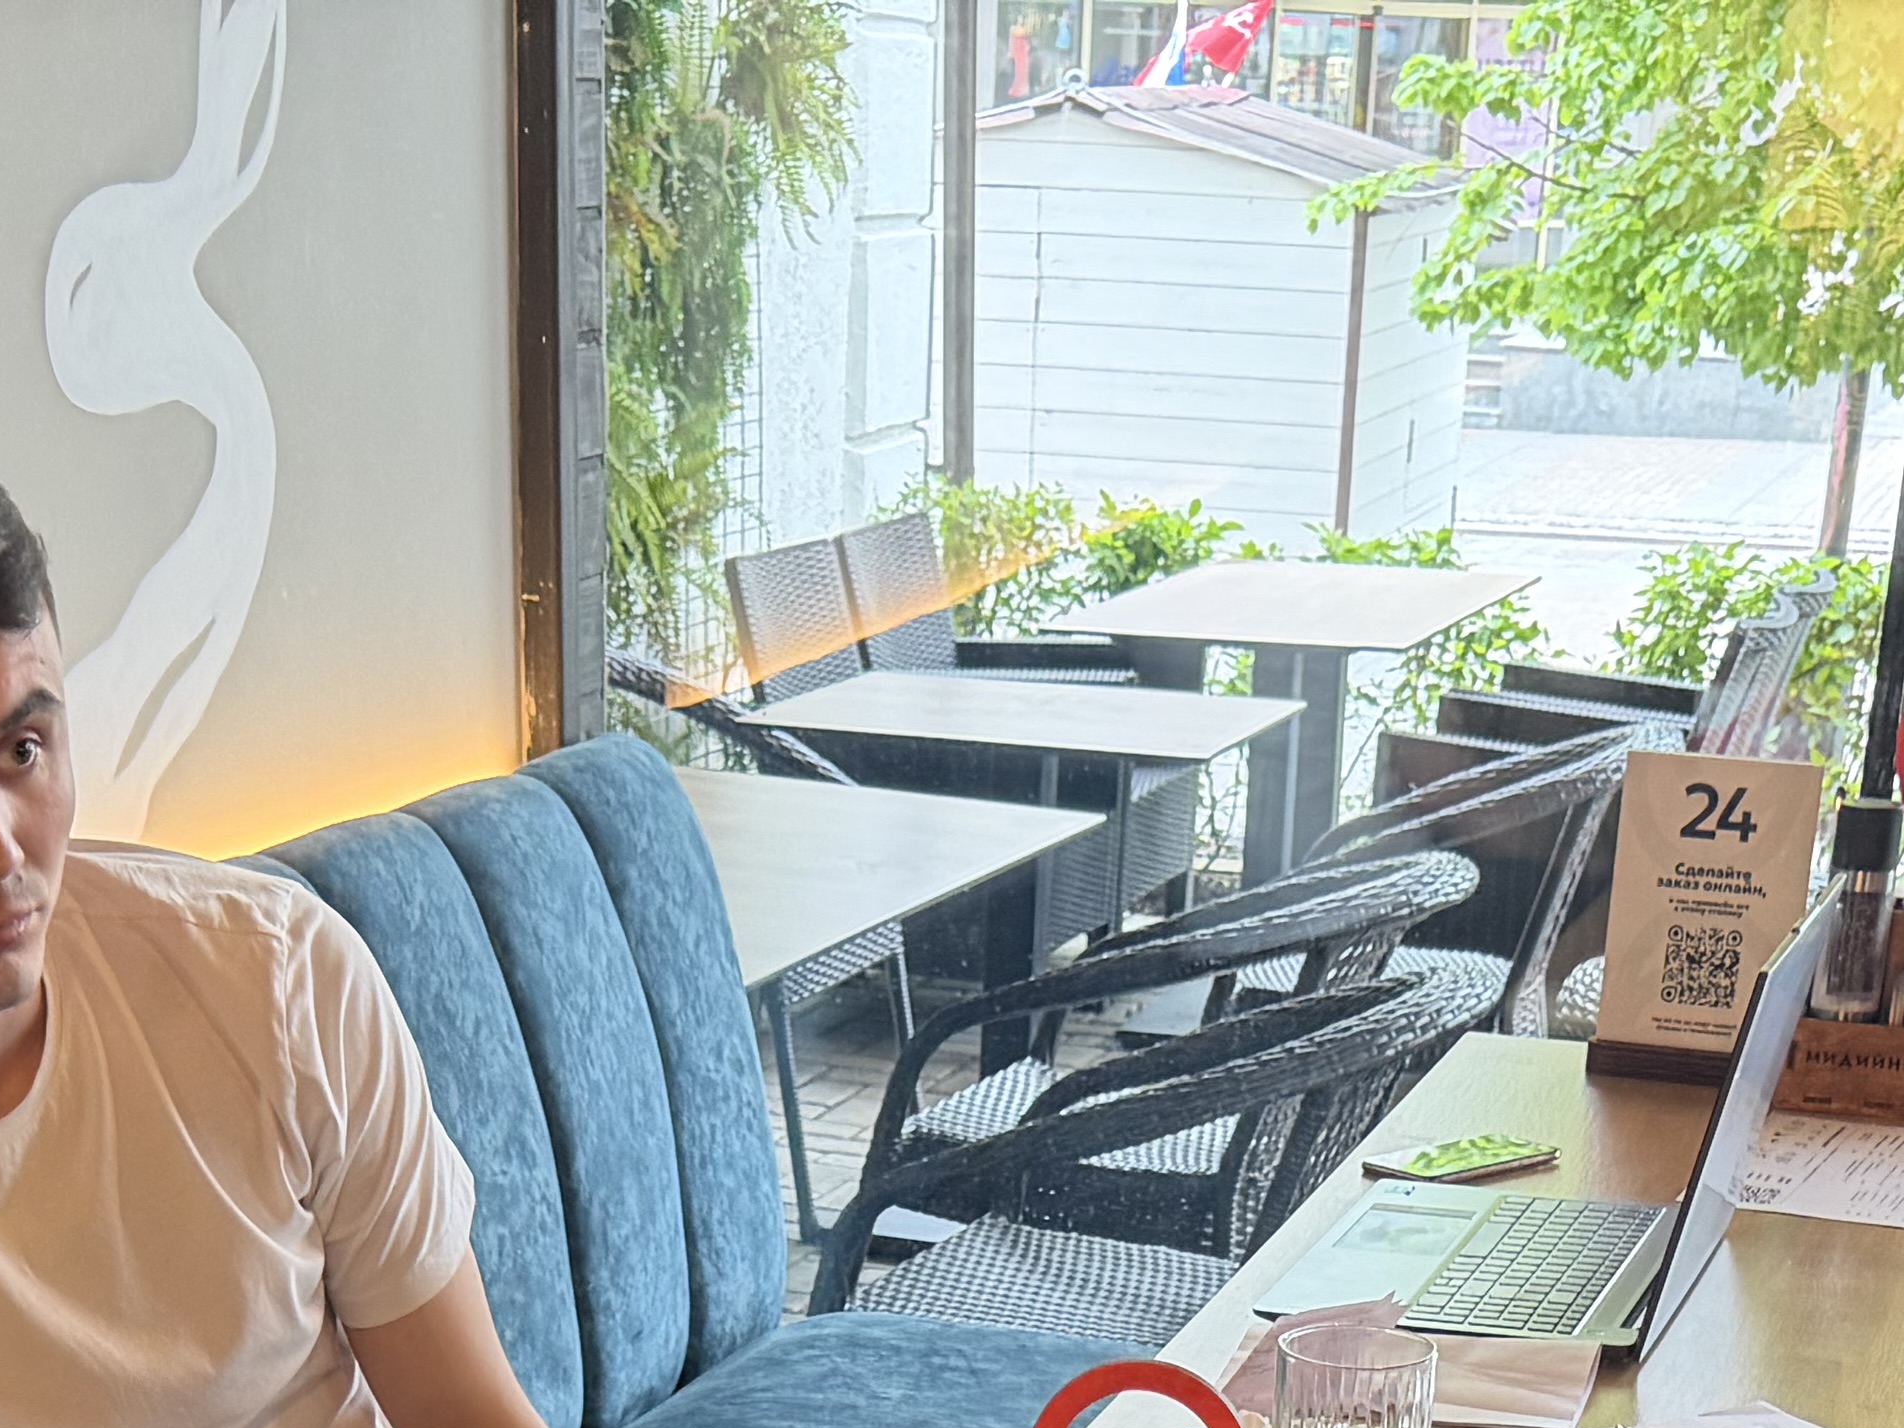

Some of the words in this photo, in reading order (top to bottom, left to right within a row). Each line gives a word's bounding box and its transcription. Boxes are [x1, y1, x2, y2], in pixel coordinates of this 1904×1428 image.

[1680, 783, 1757, 842] 24
[1675, 862, 1753, 882] Сделайте
[1657, 876, 1699, 892] заказ
[1703, 880, 1766, 898] онлайн,
